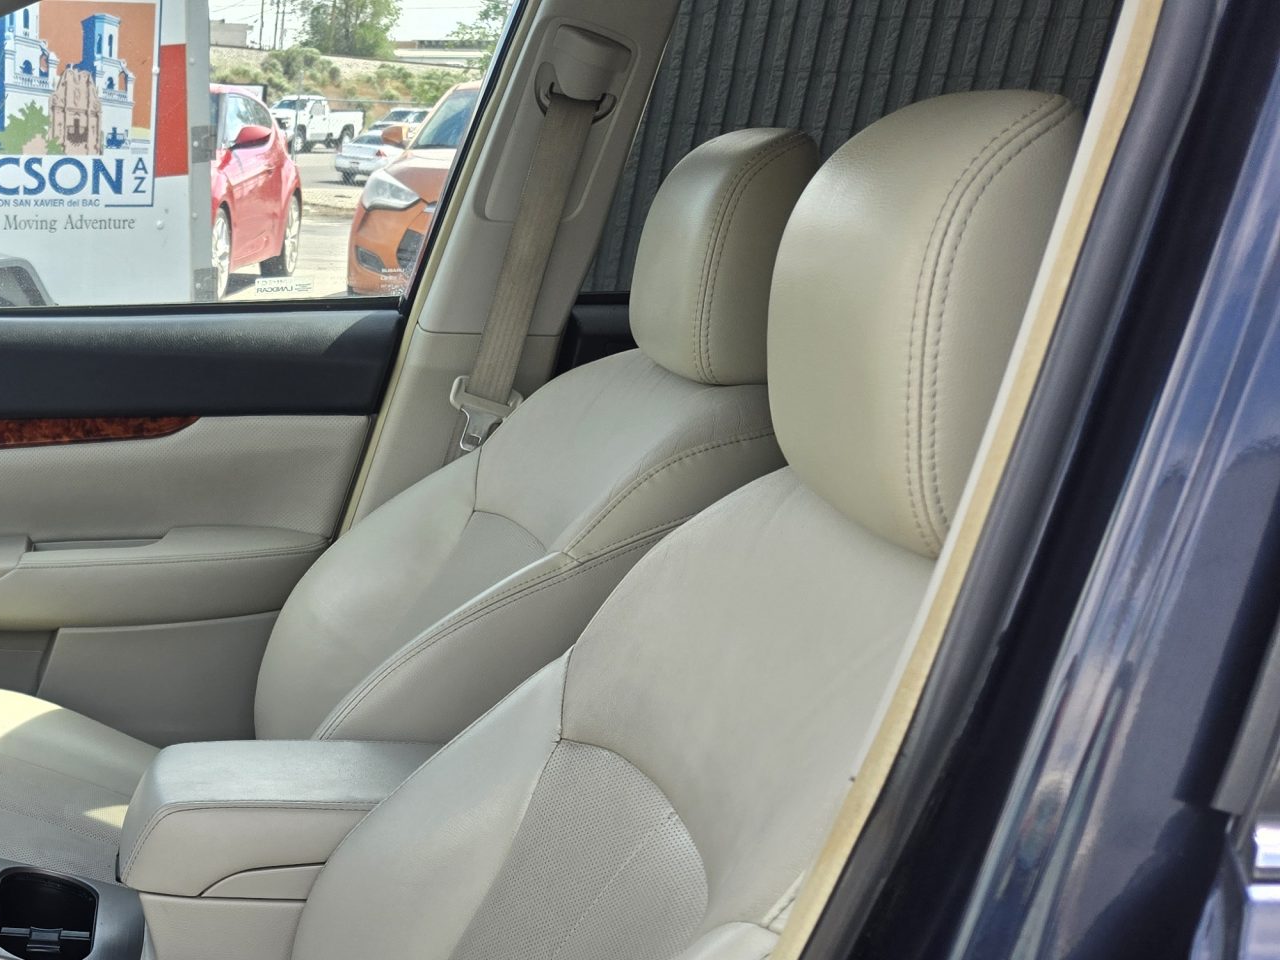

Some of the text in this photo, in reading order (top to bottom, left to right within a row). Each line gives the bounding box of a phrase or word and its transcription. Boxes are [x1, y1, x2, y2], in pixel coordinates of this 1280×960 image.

[12, 199, 32, 207] SAN
[33, 199, 65, 207] XAVIER
[67, 199, 80, 207] del
[81, 199, 100, 207] BAC
[3, 214, 58, 233] Moving
[63, 213, 136, 230] Adventure
